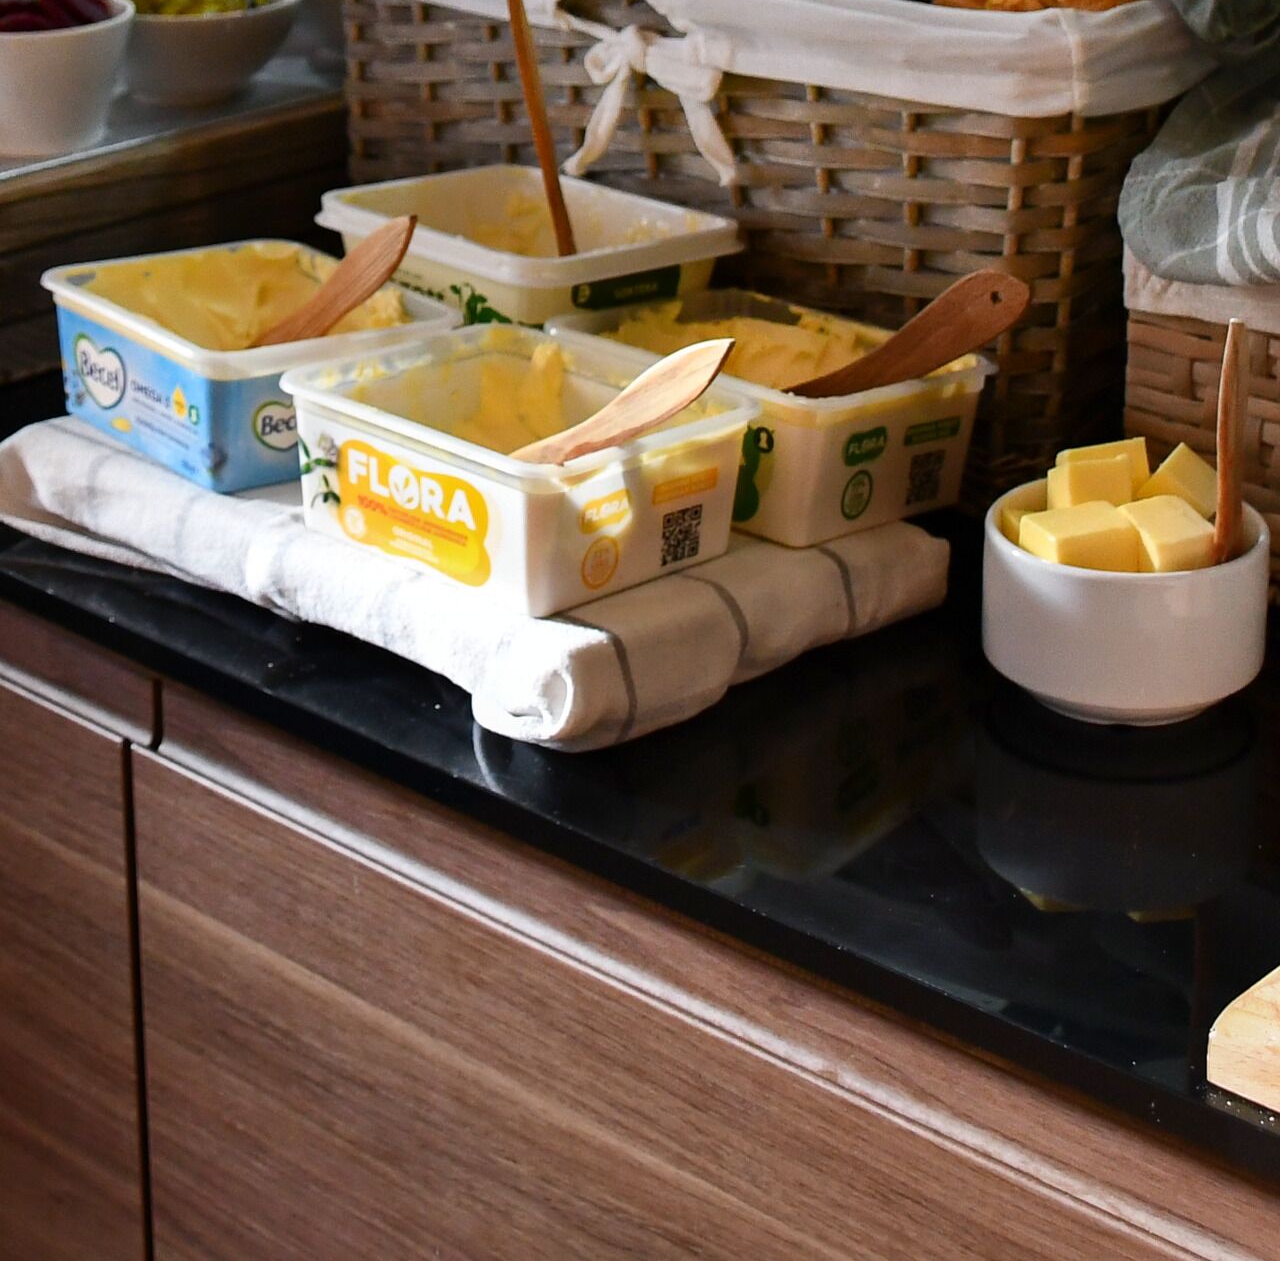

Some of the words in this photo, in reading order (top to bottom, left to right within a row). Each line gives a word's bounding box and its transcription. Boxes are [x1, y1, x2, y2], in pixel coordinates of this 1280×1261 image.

[79, 350, 120, 392] Becel
[261, 414, 297, 437] Bec
[347, 448, 477, 531] FLORA
[584, 498, 629, 523] FLORA
